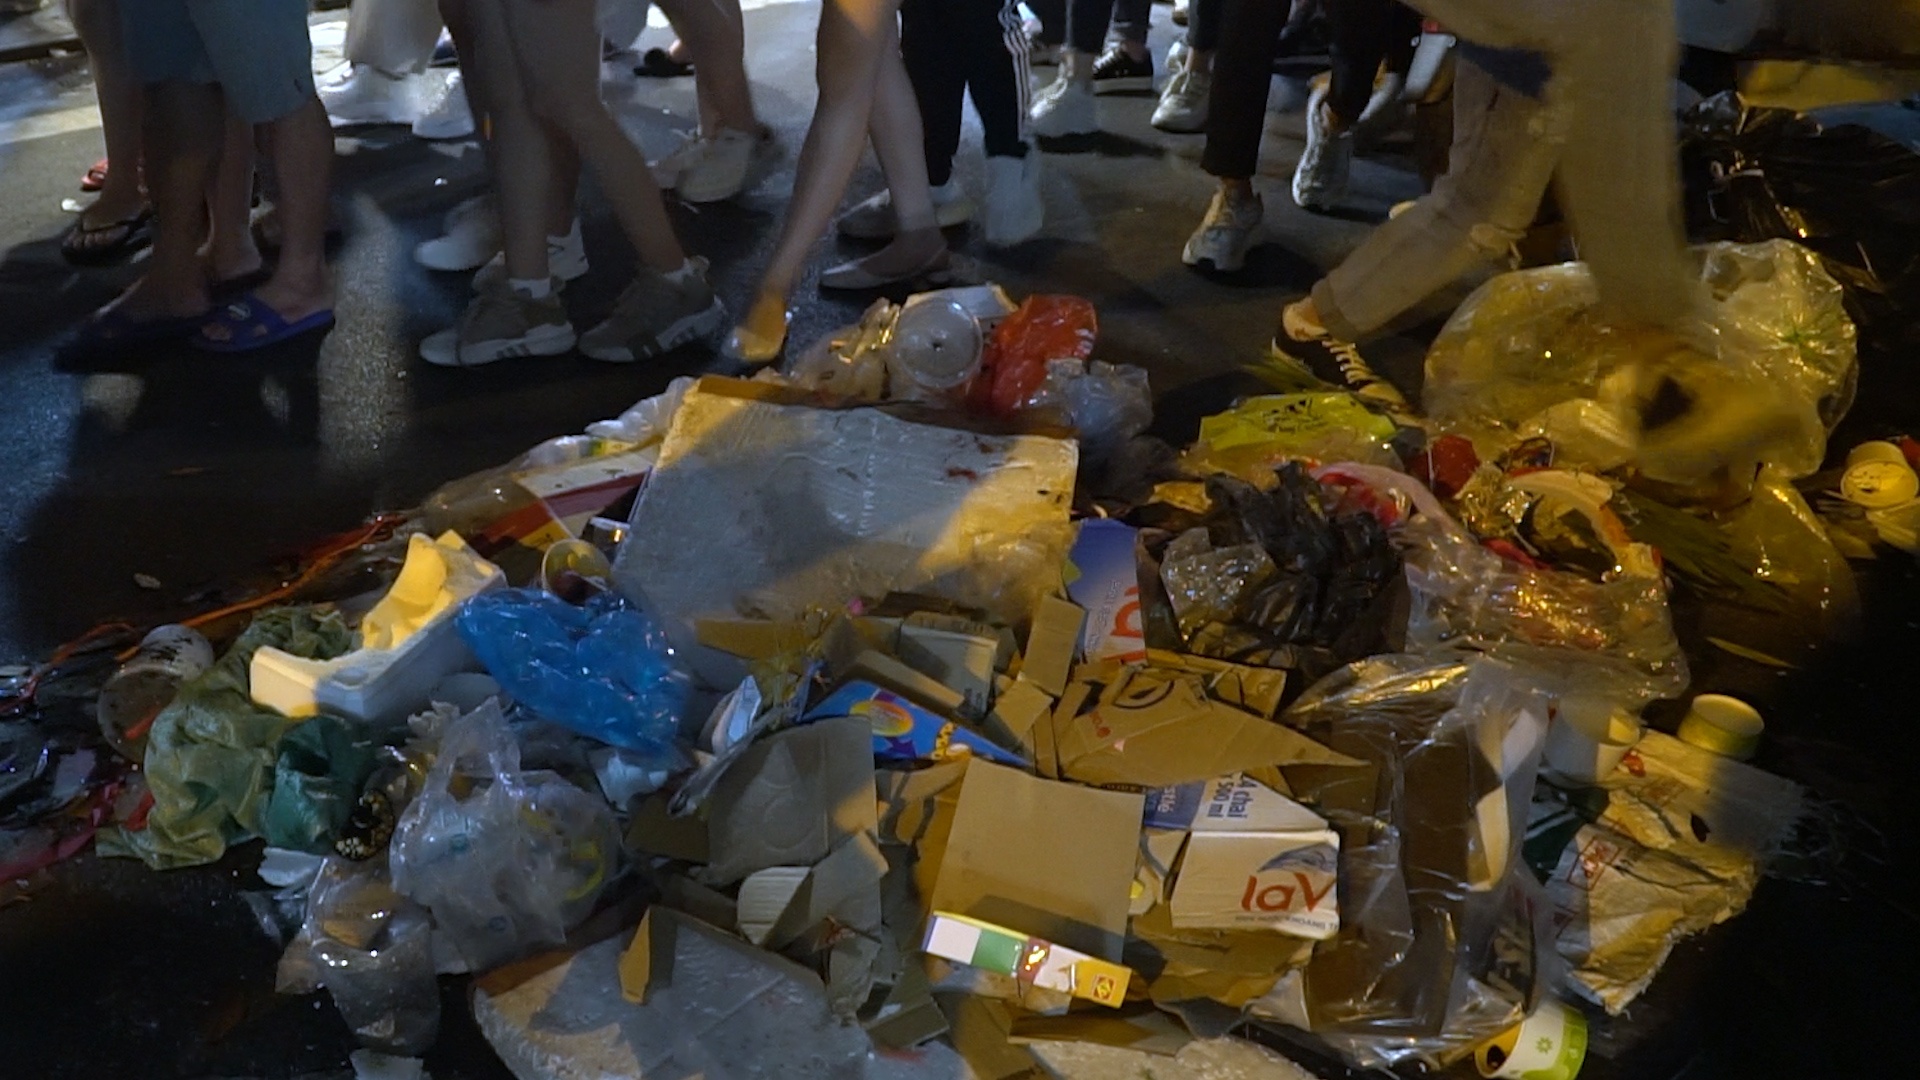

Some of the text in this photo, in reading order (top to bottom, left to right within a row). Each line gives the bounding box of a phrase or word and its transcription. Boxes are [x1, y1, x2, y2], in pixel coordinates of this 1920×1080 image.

[1213, 781, 1234, 801] 500
[1207, 803, 1224, 818] ml
[1227, 790, 1254, 819] chai
